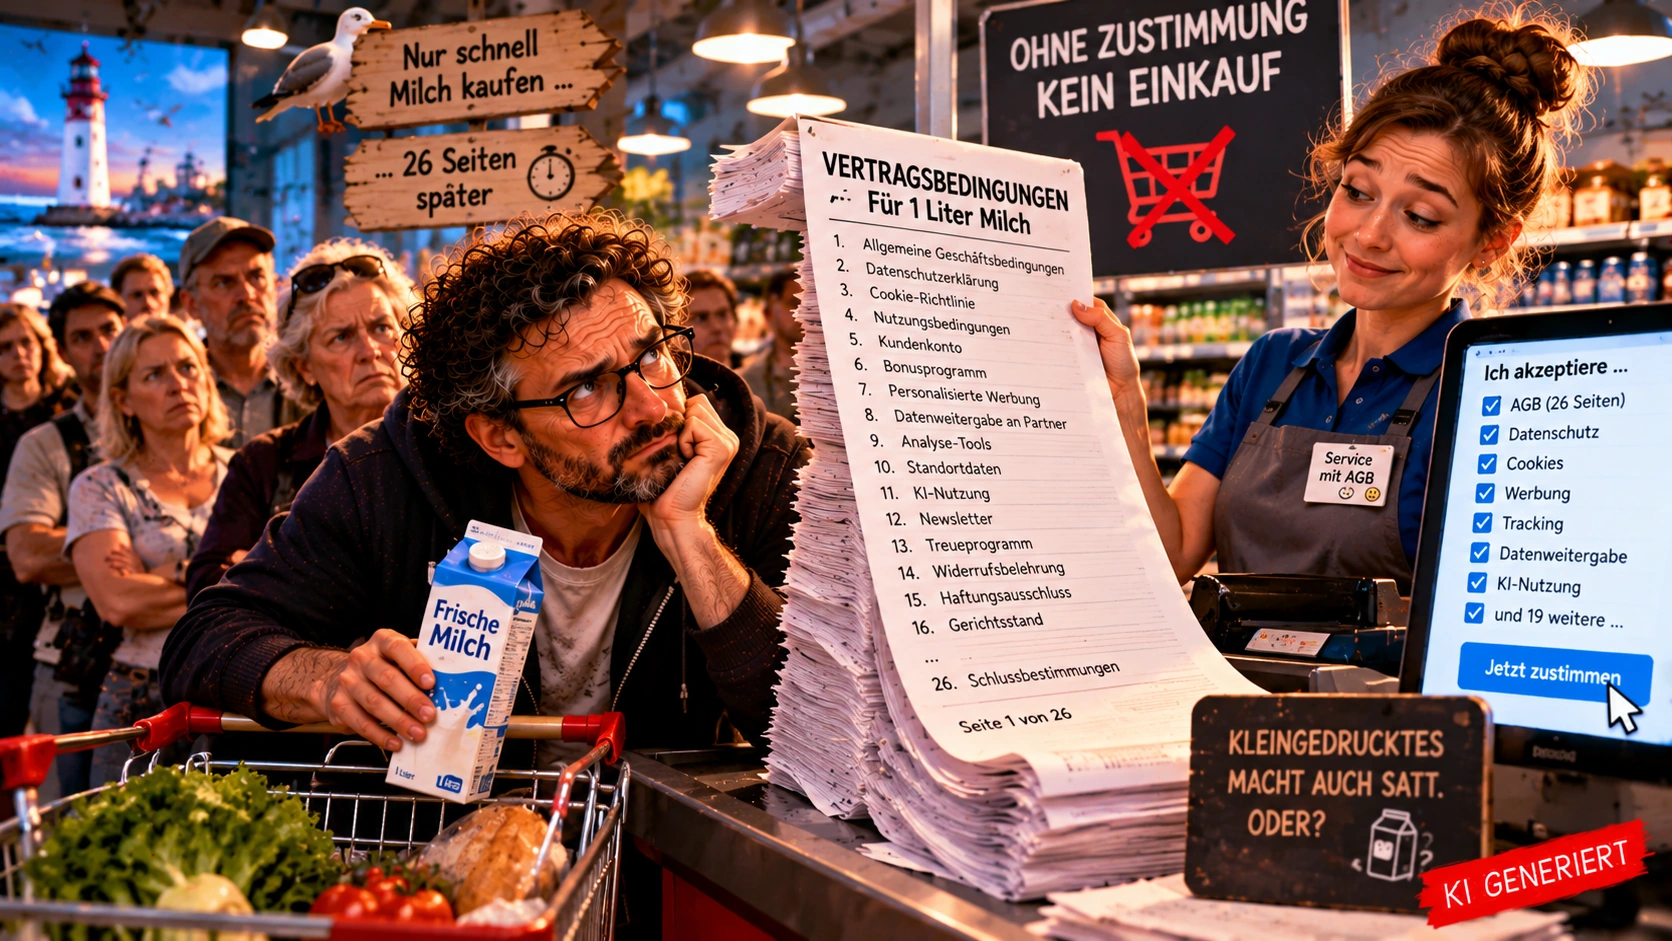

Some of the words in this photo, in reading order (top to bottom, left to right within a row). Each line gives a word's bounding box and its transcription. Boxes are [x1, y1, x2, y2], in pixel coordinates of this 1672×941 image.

[1010, 27, 1089, 72] OHNE
[1097, 0, 1308, 60] ZUSTIMMUNG
[403, 41, 448, 71] Nur
[455, 27, 539, 65] schnell
[389, 73, 452, 108] Milch
[461, 66, 545, 100] kaufen
[1037, 71, 1115, 119] KEIN
[1129, 50, 1282, 108] EINKAUF
[402, 148, 433, 177] 26
[442, 146, 517, 175] Seiten
[821, 150, 1069, 212] VERTRAGSBEDINGUNGEN
[867, 190, 904, 217] Für
[909, 196, 919, 219] 1
[925, 198, 974, 226] Liter
[979, 206, 1031, 235] Milch
[833, 233, 845, 248] 1.
[862, 237, 932, 259] Allgemeine
[836, 258, 850, 273] 2.
[865, 261, 999, 293] Datenschutzerklärung
[839, 282, 853, 297] 3.
[869, 285, 976, 310] Cookie-Richtlinie
[844, 307, 858, 322] 4.
[873, 310, 1011, 338] Nutzungsbedingungen
[849, 332, 863, 347] 5.
[878, 334, 963, 354] Kundenkonto
[854, 357, 868, 371] 6.
[883, 359, 988, 380] Bonusprogramm
[1484, 363, 1510, 382] Ich
[1513, 358, 1608, 382] akzeptiere
[857, 381, 872, 396] 7.
[888, 383, 983, 403] Personalisierte
[984, 390, 1041, 409] Werbung
[1510, 396, 1542, 412] AGB
[1545, 395, 1569, 413] (26
[1573, 391, 1626, 410] Seiten)
[864, 407, 878, 422] 8.
[893, 409, 1003, 430] Datenweitergabe
[1006, 418, 1022, 428] an
[1023, 415, 1067, 430] Partner
[869, 433, 884, 448] 9.
[901, 434, 992, 452] Analyse-Tools
[1508, 424, 1600, 442] Datenschutz
[874, 459, 895, 474] 10.
[906, 459, 1002, 476] Standortdaten
[1324, 451, 1373, 467] Service
[1506, 455, 1564, 471] Cookies
[1319, 468, 1342, 483] mit
[1344, 469, 1375, 485] AGB
[880, 485, 899, 500] 11.
[912, 486, 991, 503] KI-Nutzung
[1504, 485, 1571, 504] Werbung
[885, 511, 907, 526] 12.
[919, 511, 993, 526] Newsletter
[1502, 515, 1564, 535] Tracking
[891, 538, 913, 554] 13.
[924, 538, 1034, 555] Treueprogramm
[1499, 545, 1628, 567] Datenweitergabe
[897, 565, 920, 581] 14.
[931, 561, 1066, 579] Widerrufsbelehrung
[904, 592, 927, 608] 15.
[939, 585, 1072, 607] Haftungsausschluss
[1497, 576, 1582, 599] KI-Nutzung
[433, 598, 500, 635] Frische
[911, 619, 935, 635] 16.
[948, 611, 1044, 633] Gerichtsstand
[1494, 607, 1523, 623] und
[1527, 608, 1544, 624] 19
[1548, 610, 1606, 628] weitere
[428, 623, 491, 661] Milch
[931, 675, 958, 692] 26.
[967, 662, 1121, 688] Schlussbestimmungen
[1484, 658, 1527, 679] Jetzt
[1529, 665, 1622, 687] zustimmen
[958, 718, 1003, 734] Seite
[1004, 714, 1016, 727] 1
[1018, 713, 1049, 725] von
[1049, 707, 1073, 721] 26
[1228, 728, 1444, 758] KLEINGEDRUCKTES
[1227, 768, 1306, 795] MACHT
[1311, 769, 1373, 797] AUCH
[1381, 770, 1444, 799] SATT.
[1247, 808, 1326, 838] ODER?
